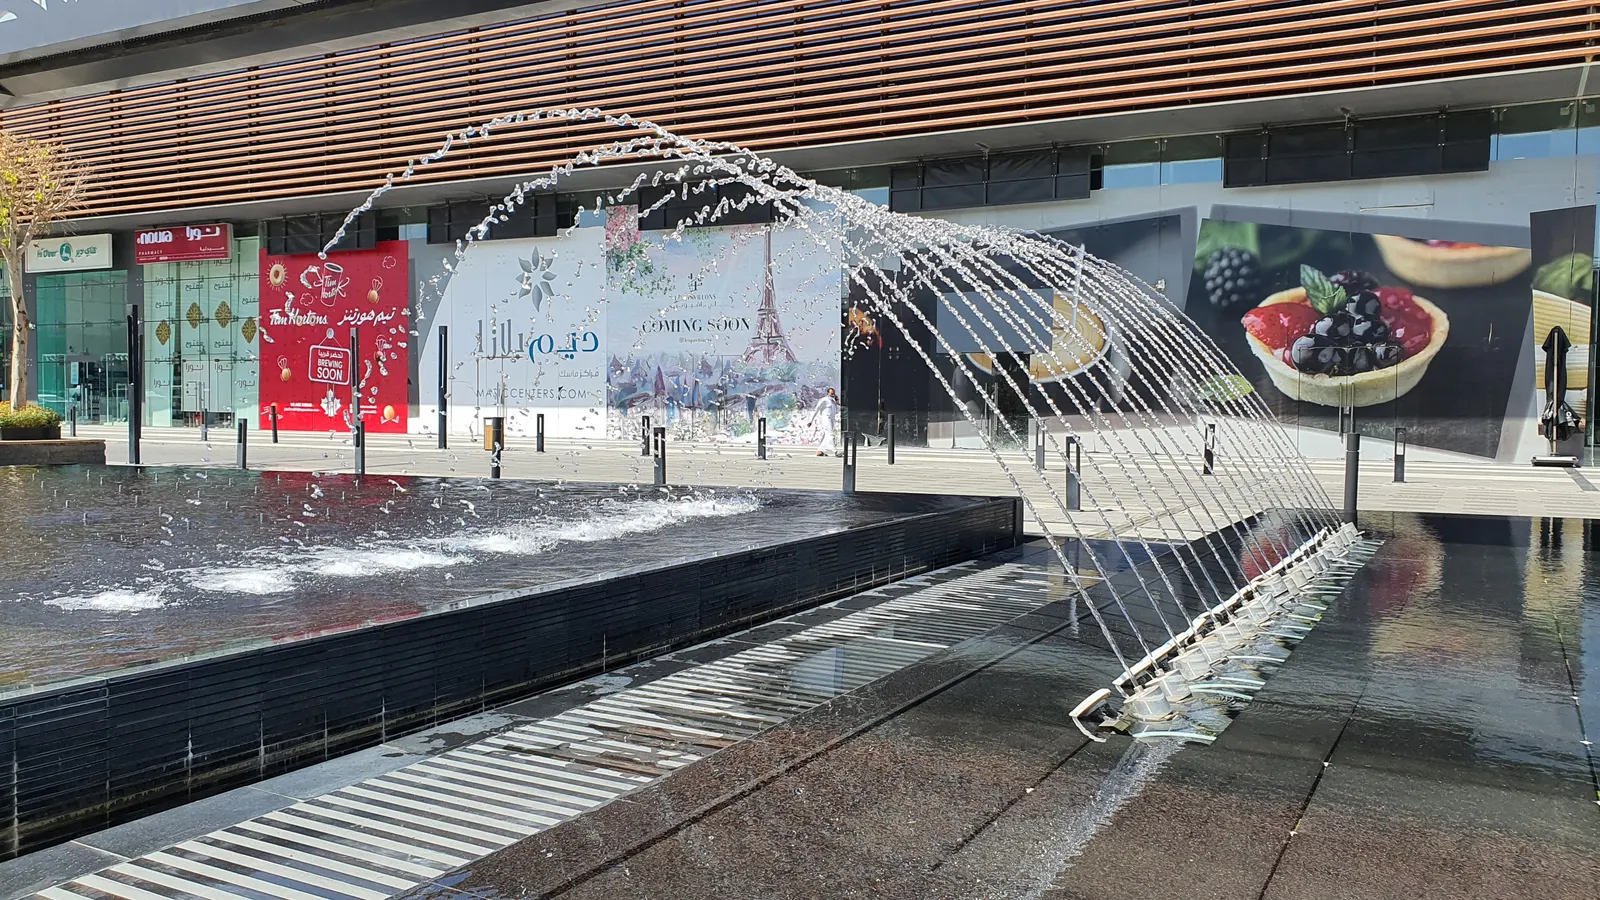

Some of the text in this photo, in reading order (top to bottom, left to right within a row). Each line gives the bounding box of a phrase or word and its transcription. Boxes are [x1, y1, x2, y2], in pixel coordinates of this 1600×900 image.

[137, 230, 173, 245] noura
[186, 226, 220, 241] نورا
[288, 307, 328, 326] Hortons
[373, 307, 397, 327] تيم
[642, 318, 751, 333] COMING SOON
[317, 359, 343, 369] BREWING
[317, 367, 343, 381] SOON
